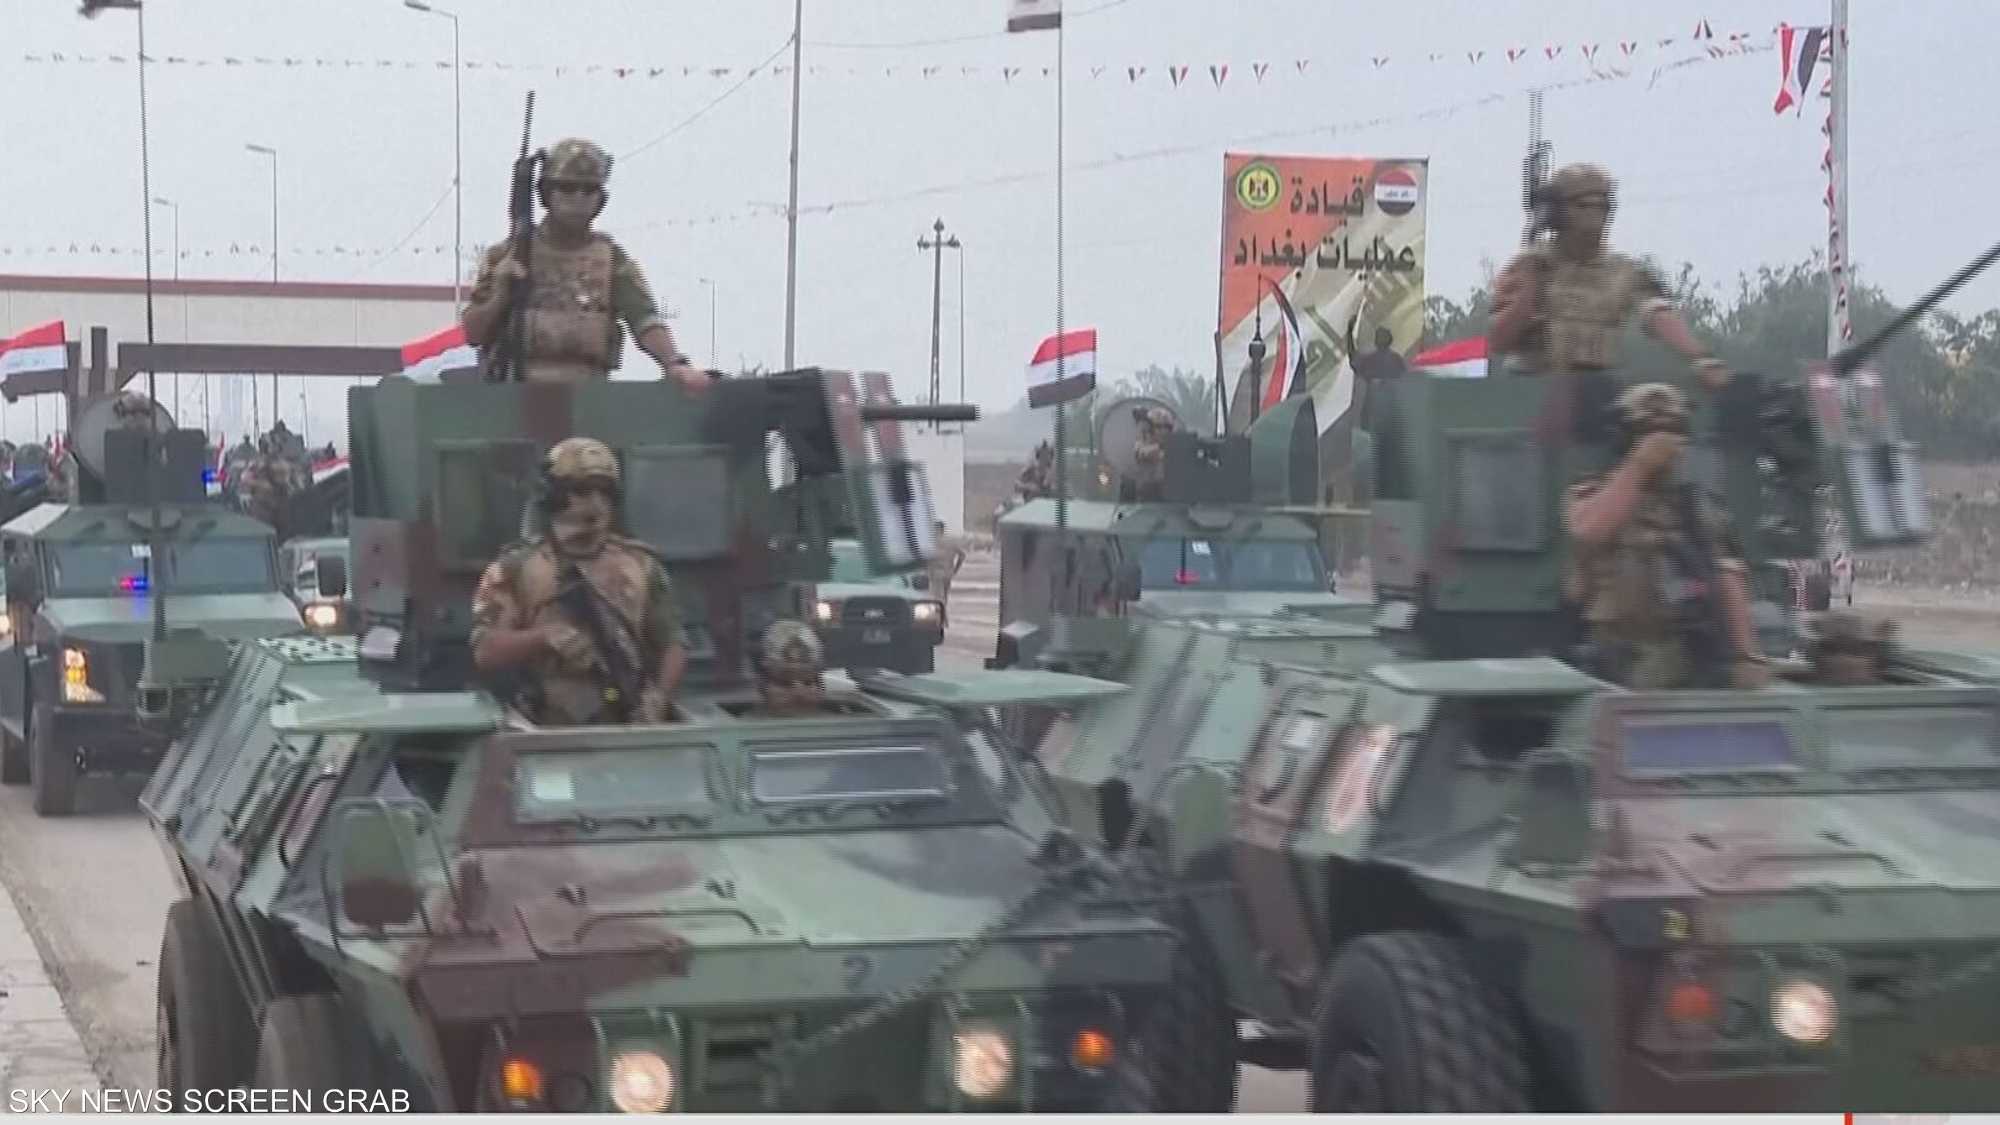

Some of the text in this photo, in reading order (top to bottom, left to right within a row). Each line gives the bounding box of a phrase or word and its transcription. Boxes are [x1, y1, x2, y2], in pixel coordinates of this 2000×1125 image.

[1289, 175, 1365, 227] قيادة
[1234, 228, 1416, 281] عمليات بغداد
